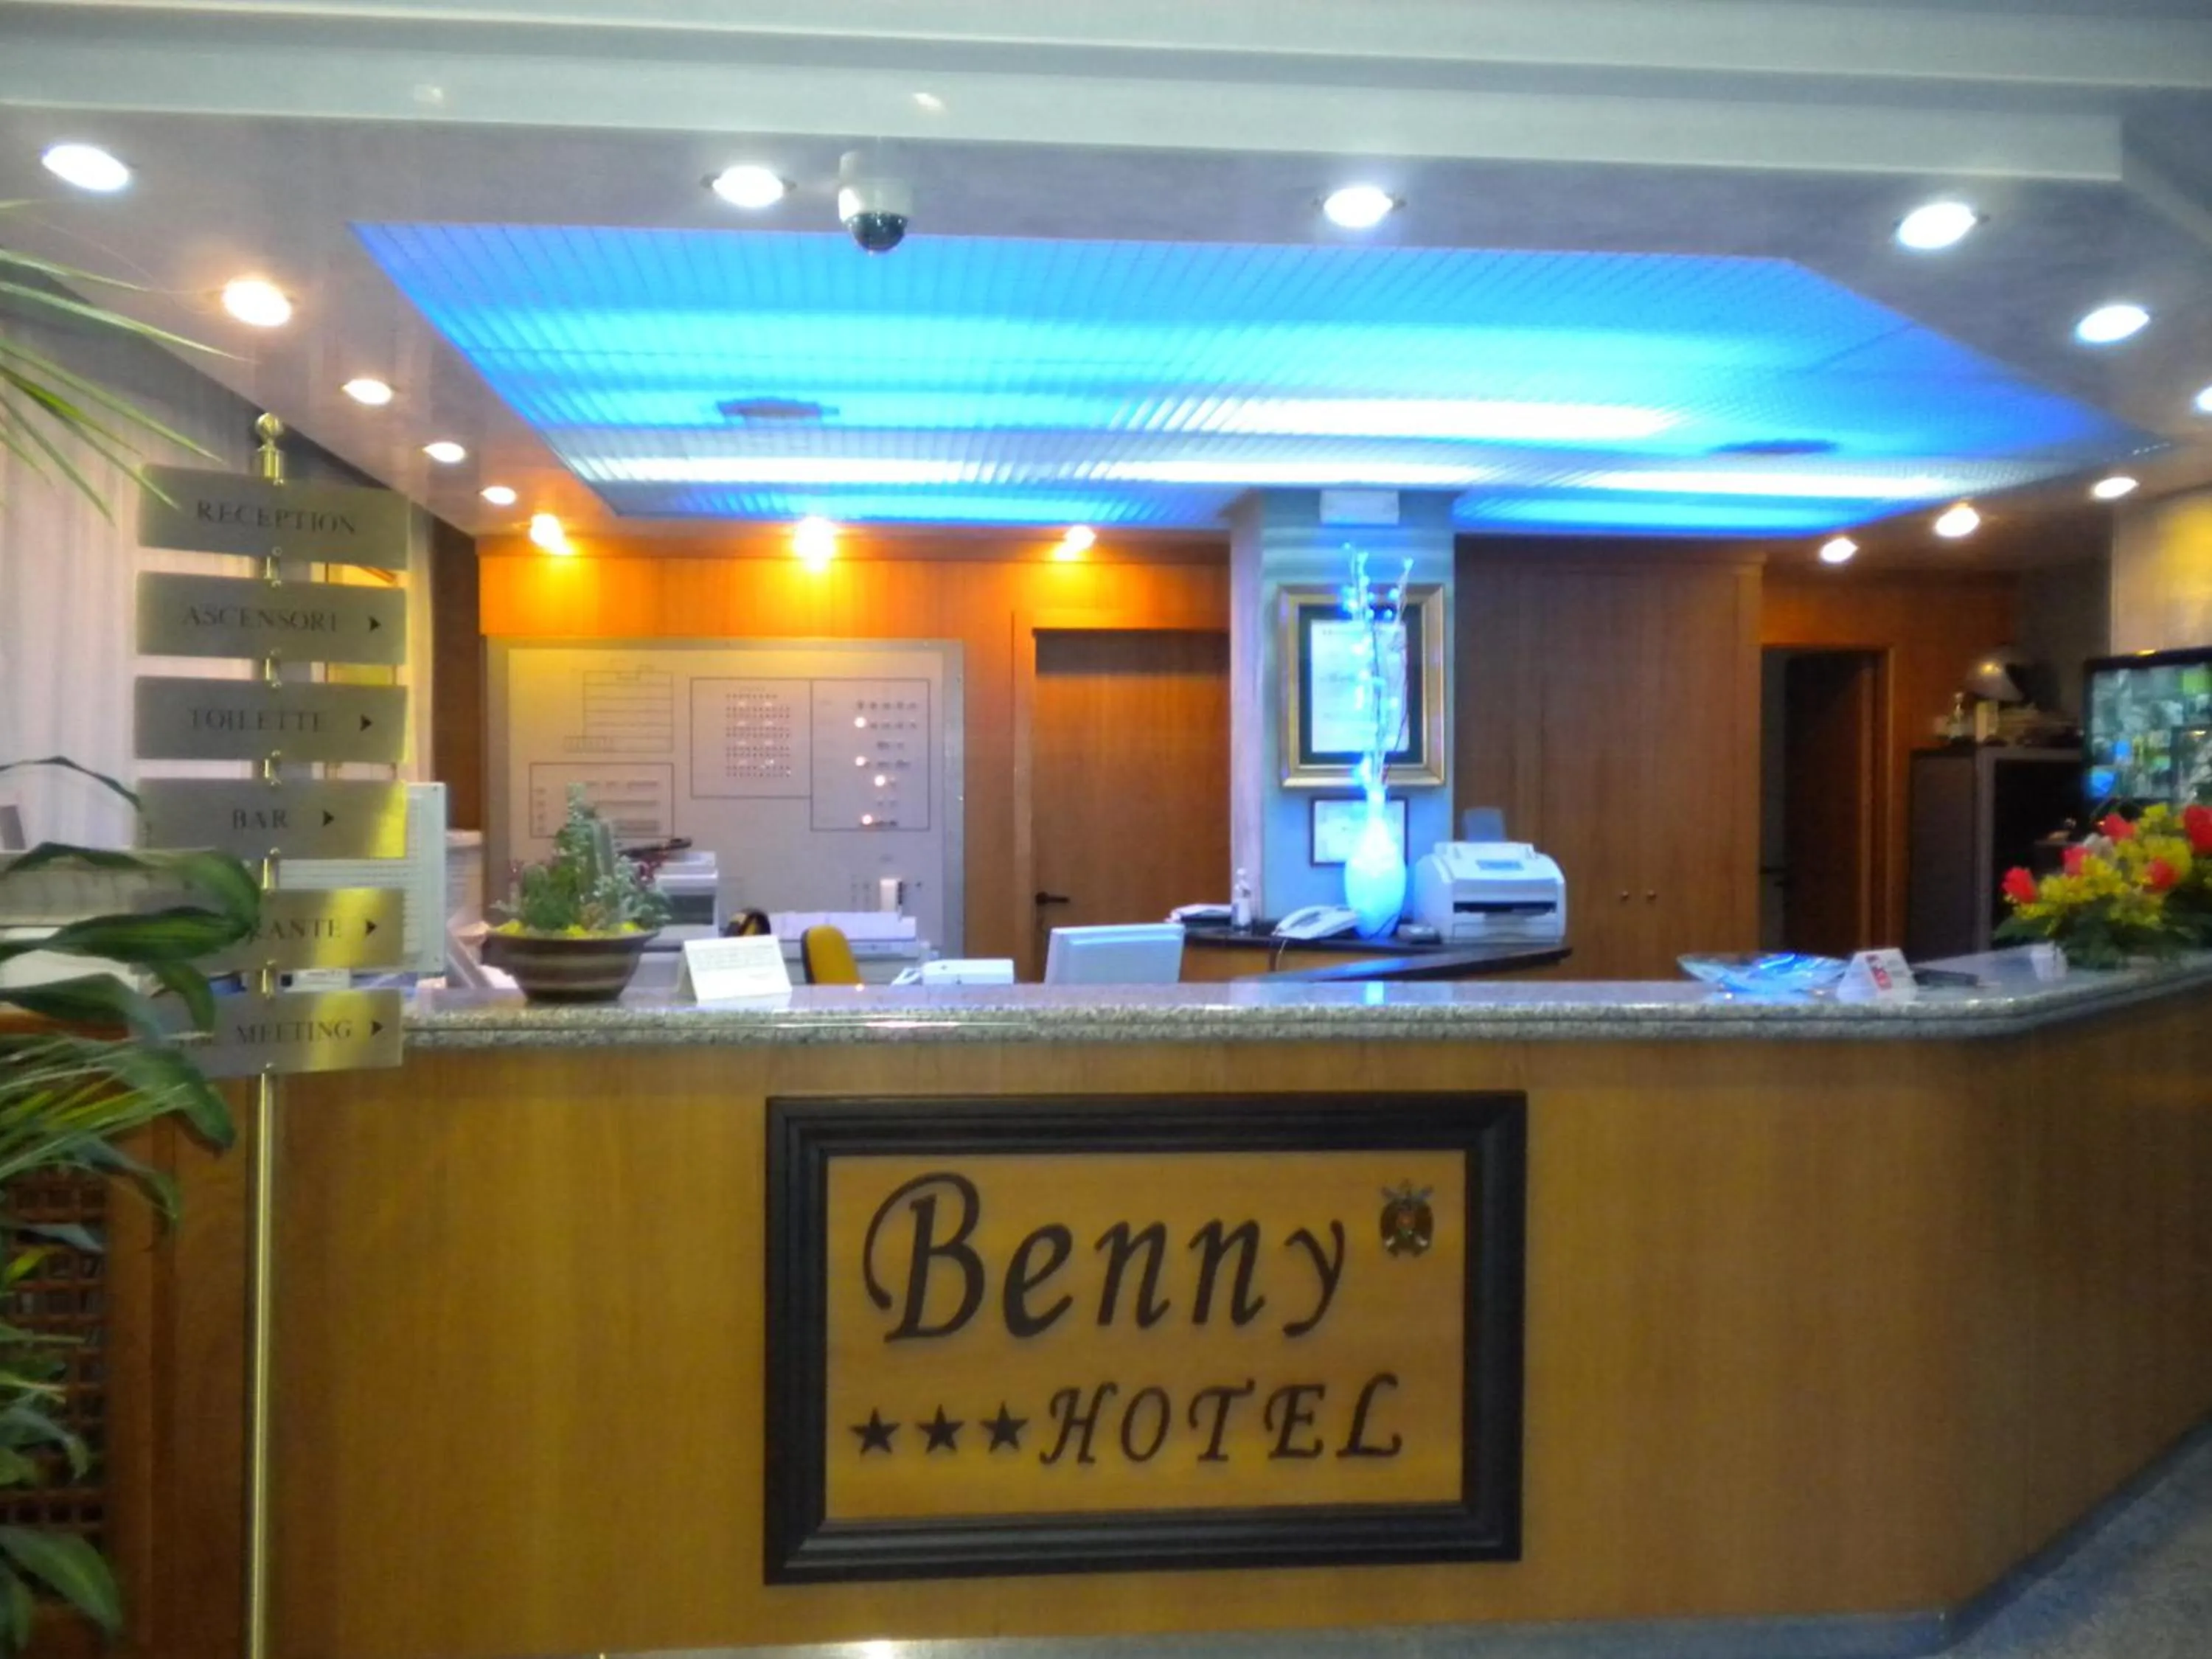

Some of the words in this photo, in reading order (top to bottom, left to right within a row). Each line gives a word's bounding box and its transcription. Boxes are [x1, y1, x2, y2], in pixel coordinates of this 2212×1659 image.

[195, 499, 357, 535] RECEPTION
[182, 605, 338, 632] ASCENSORI
[187, 708, 329, 734] TOILETTE
[232, 809, 288, 829] BAR
[236, 1018, 352, 1044] MEETING
[861, 1171, 1345, 1344] Benny
[1038, 1372, 1402, 1466] HOTEL
